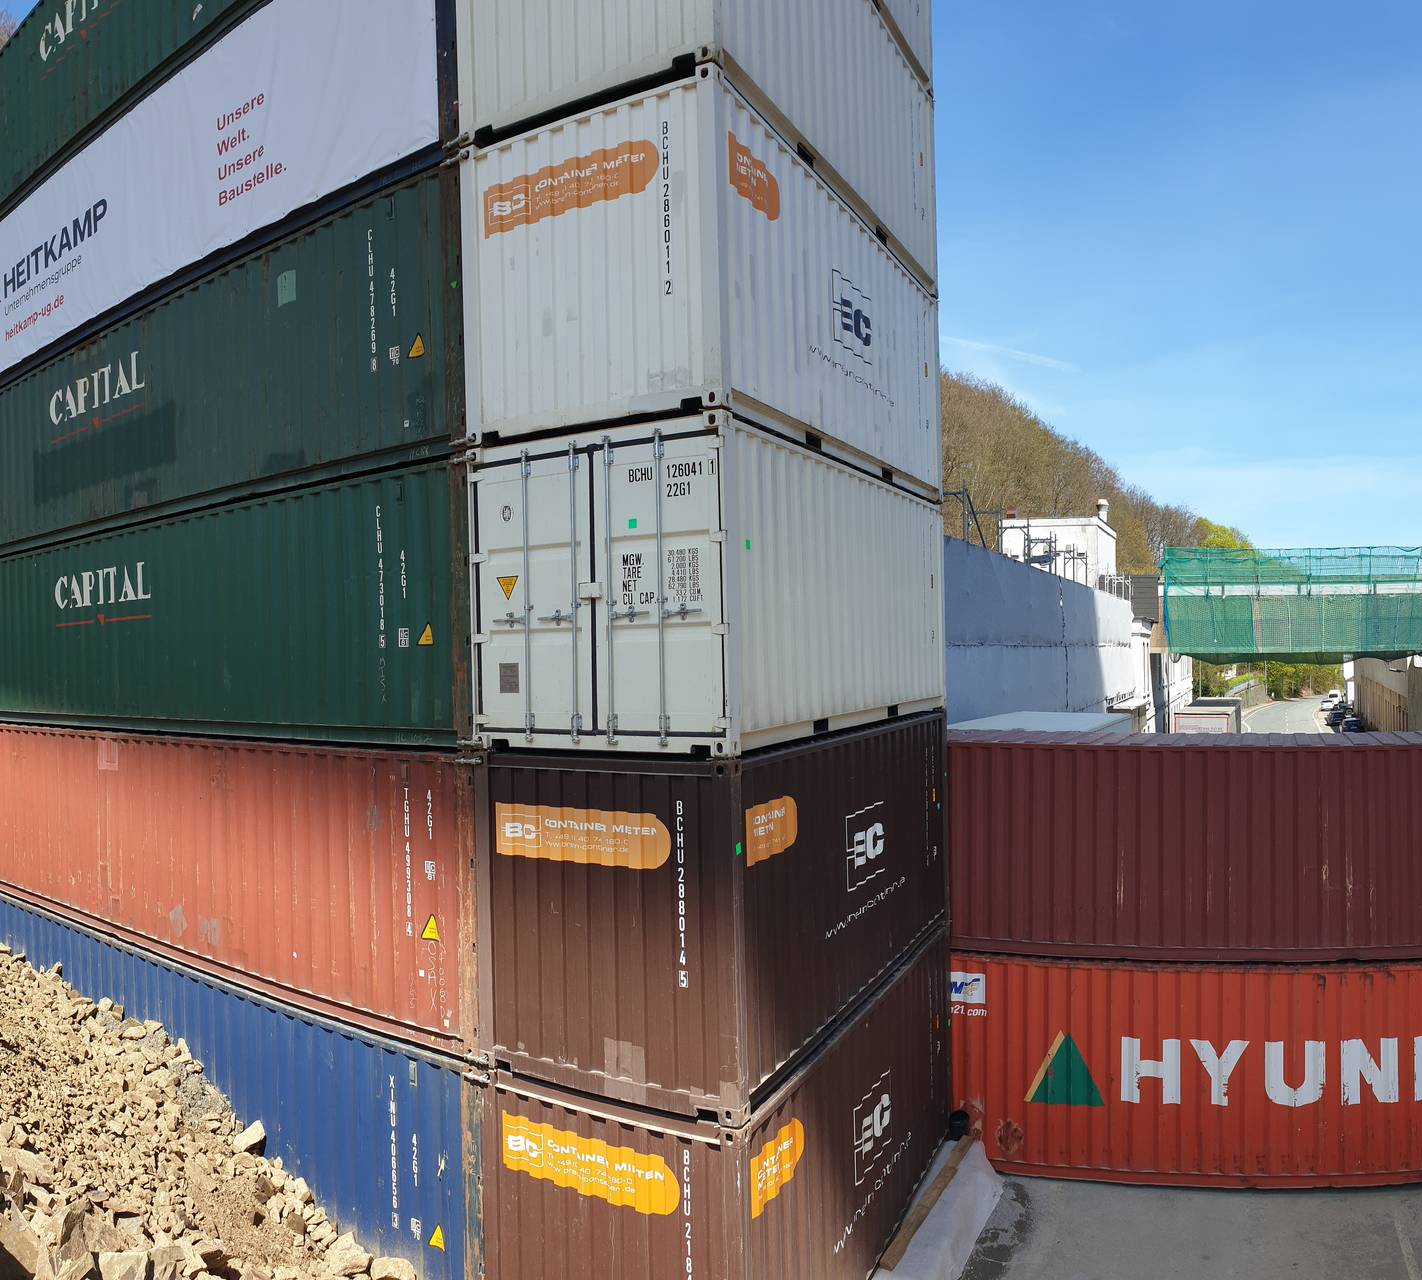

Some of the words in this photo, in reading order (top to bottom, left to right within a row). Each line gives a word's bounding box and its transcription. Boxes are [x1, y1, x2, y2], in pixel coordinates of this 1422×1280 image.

[216, 92, 265, 131] Unsere
[217, 128, 250, 156] Welt.
[217, 144, 265, 182] Unsere
[217, 163, 287, 207] Baustelle.
[3, 198, 108, 299] HEITKAMP
[663, 183, 671, 275] 286011
[4, 255, 83, 316] Unternehmensgruppe
[389, 268, 397, 317] 42G1
[4, 294, 65, 342] heitkamp-ug.de
[369, 281, 377, 354] 478269
[49, 350, 146, 426] CAPITAL
[628, 466, 653, 484] BCHU
[666, 461, 703, 480] 126041
[707, 458, 716, 476] 1
[666, 481, 691, 498] 22G1
[375, 505, 383, 554] CLHU
[622, 552, 645, 567] MGW.
[622, 566, 642, 580] TARE
[54, 561, 152, 610] CAPITAL
[622, 580, 638, 593] NET
[622, 592, 636, 606] CU.
[639, 592, 657, 605] CAP.
[505, 822, 536, 840] BC
[676, 801, 684, 864] BCHU
[677, 867, 686, 966] 288014
[683, 1149, 691, 1216] BCHU
